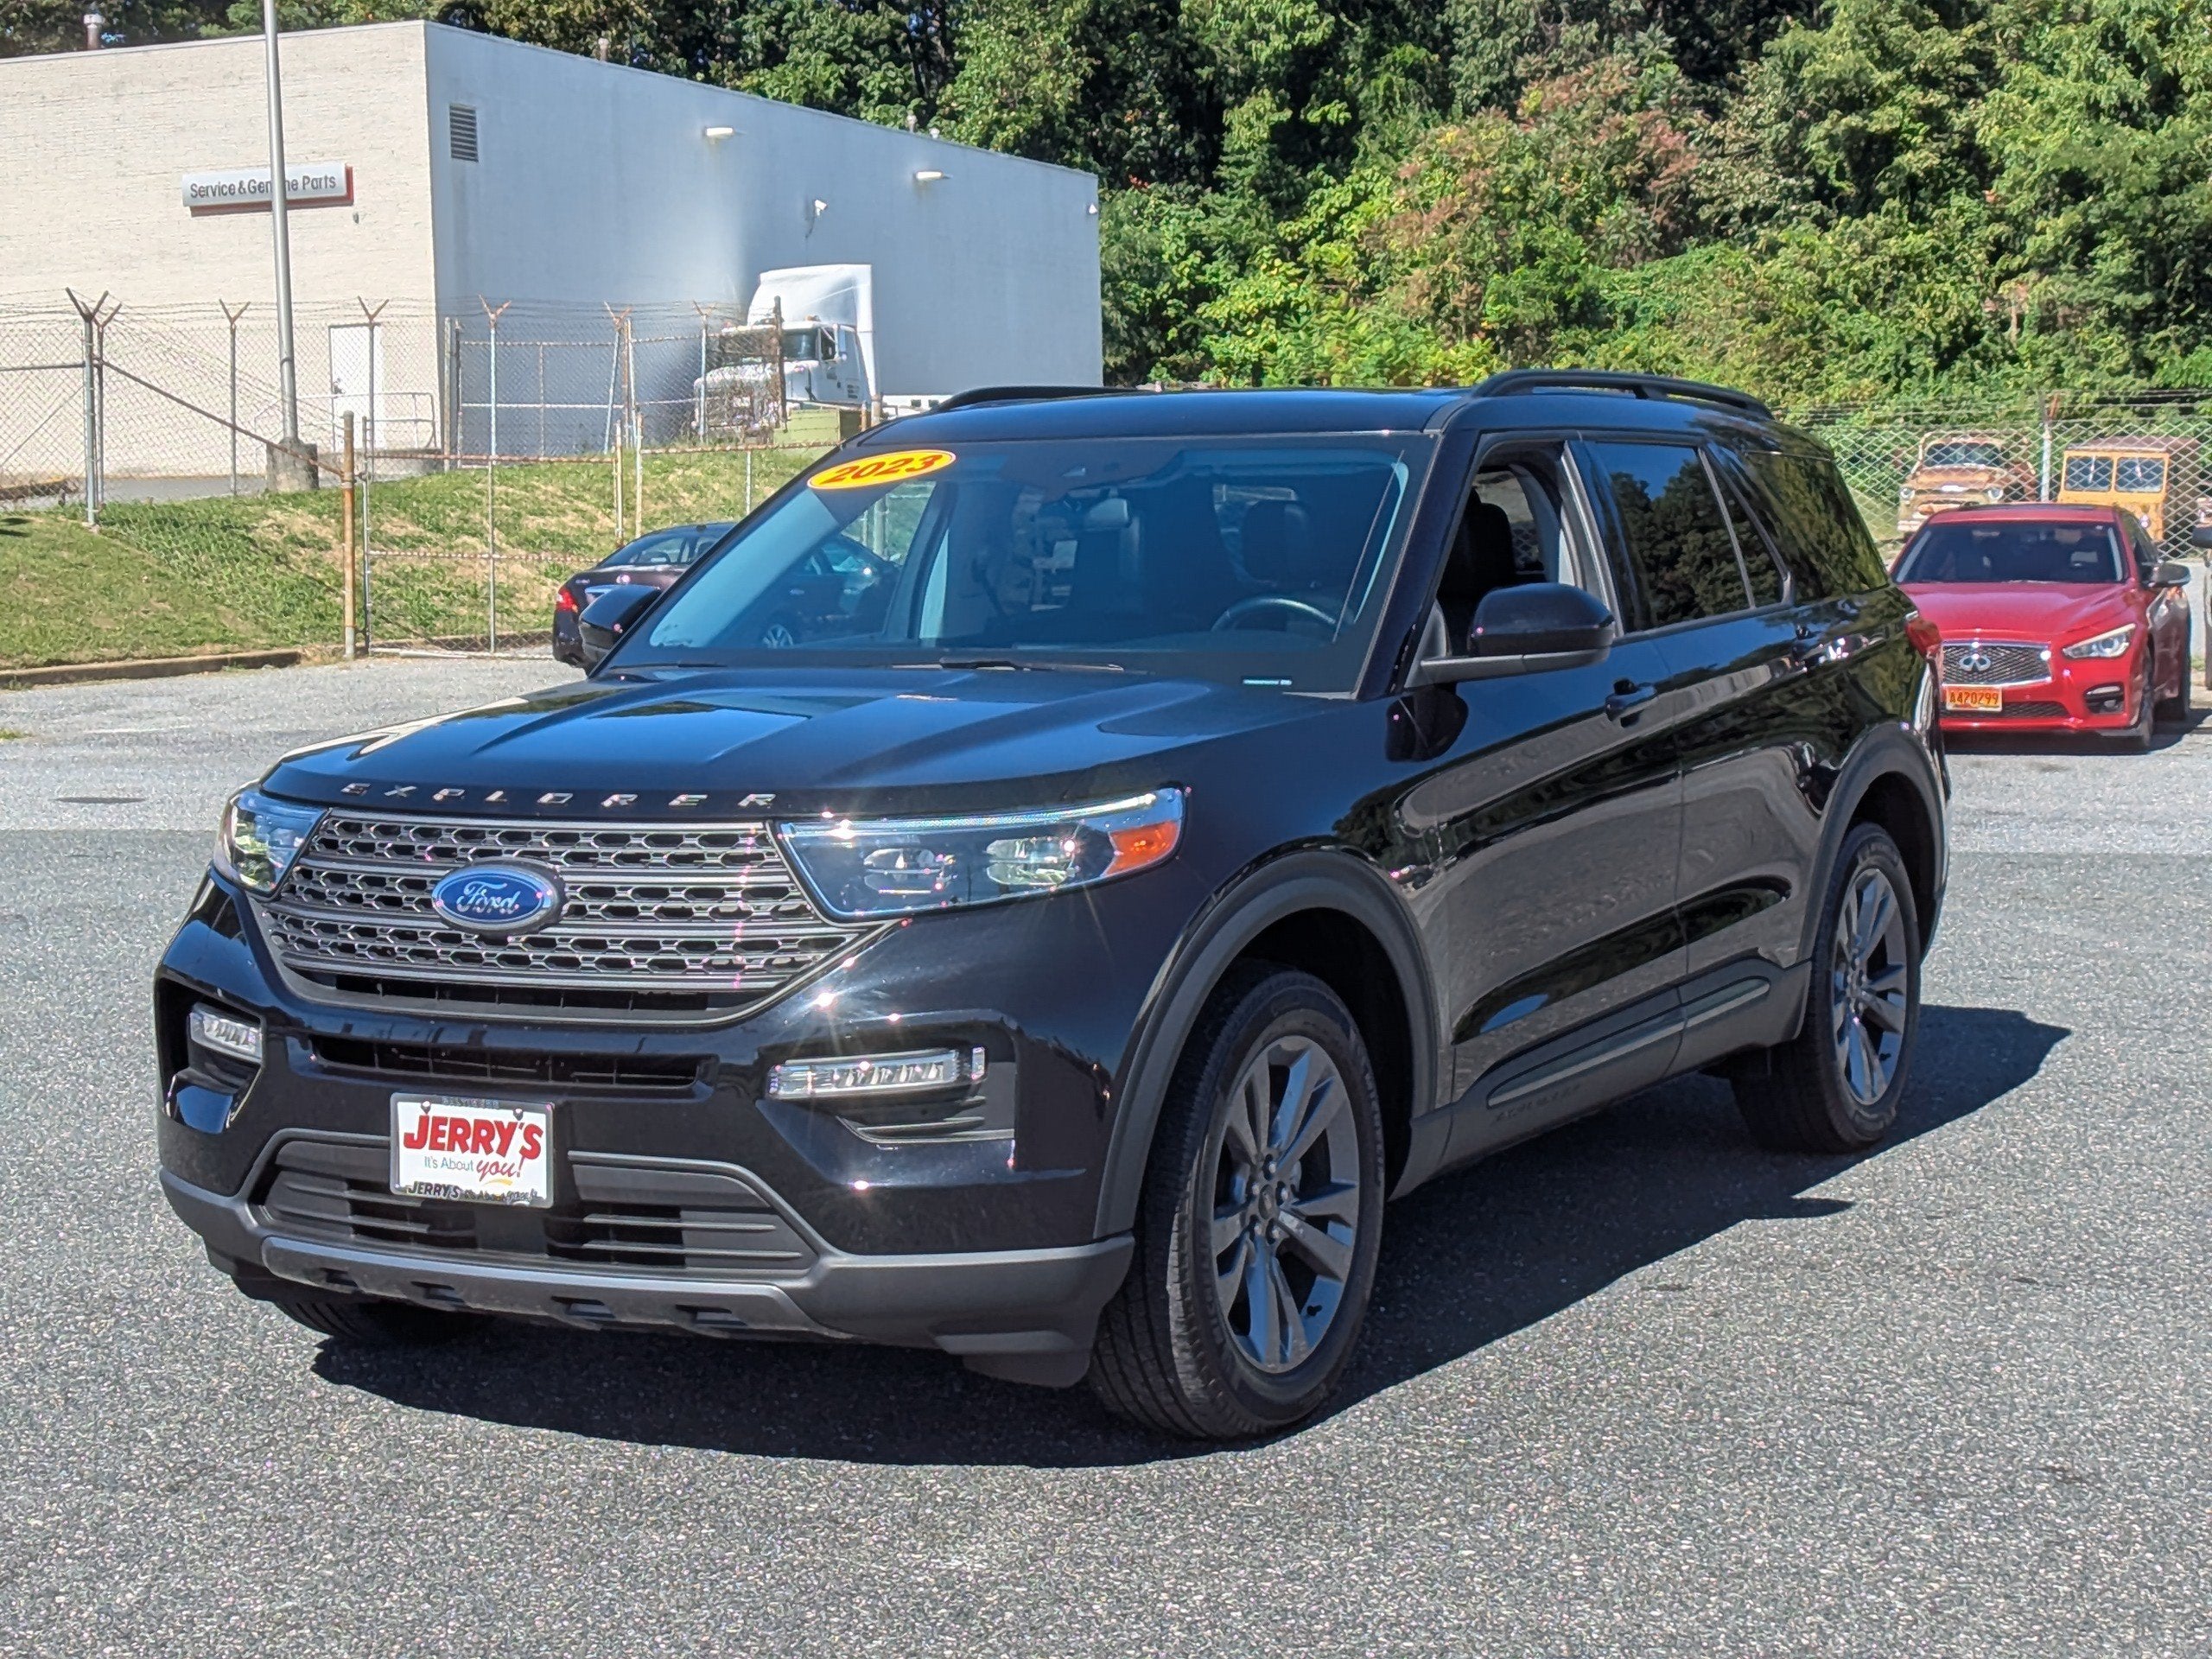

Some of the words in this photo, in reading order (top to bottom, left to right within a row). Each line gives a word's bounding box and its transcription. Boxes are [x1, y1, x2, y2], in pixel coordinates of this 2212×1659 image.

[189, 181, 236, 199] Service
[238, 180, 246, 195] &
[247, 178, 299, 195] Genne
[302, 174, 337, 191] Parts
[819, 454, 944, 485] 2023
[340, 782, 778, 807] EXPLORER
[455, 880, 521, 915] Ford
[403, 1115, 544, 1160] JERRY'S
[423, 1155, 438, 1169] It's
[441, 1156, 474, 1173] About
[476, 1155, 525, 1182] you!
